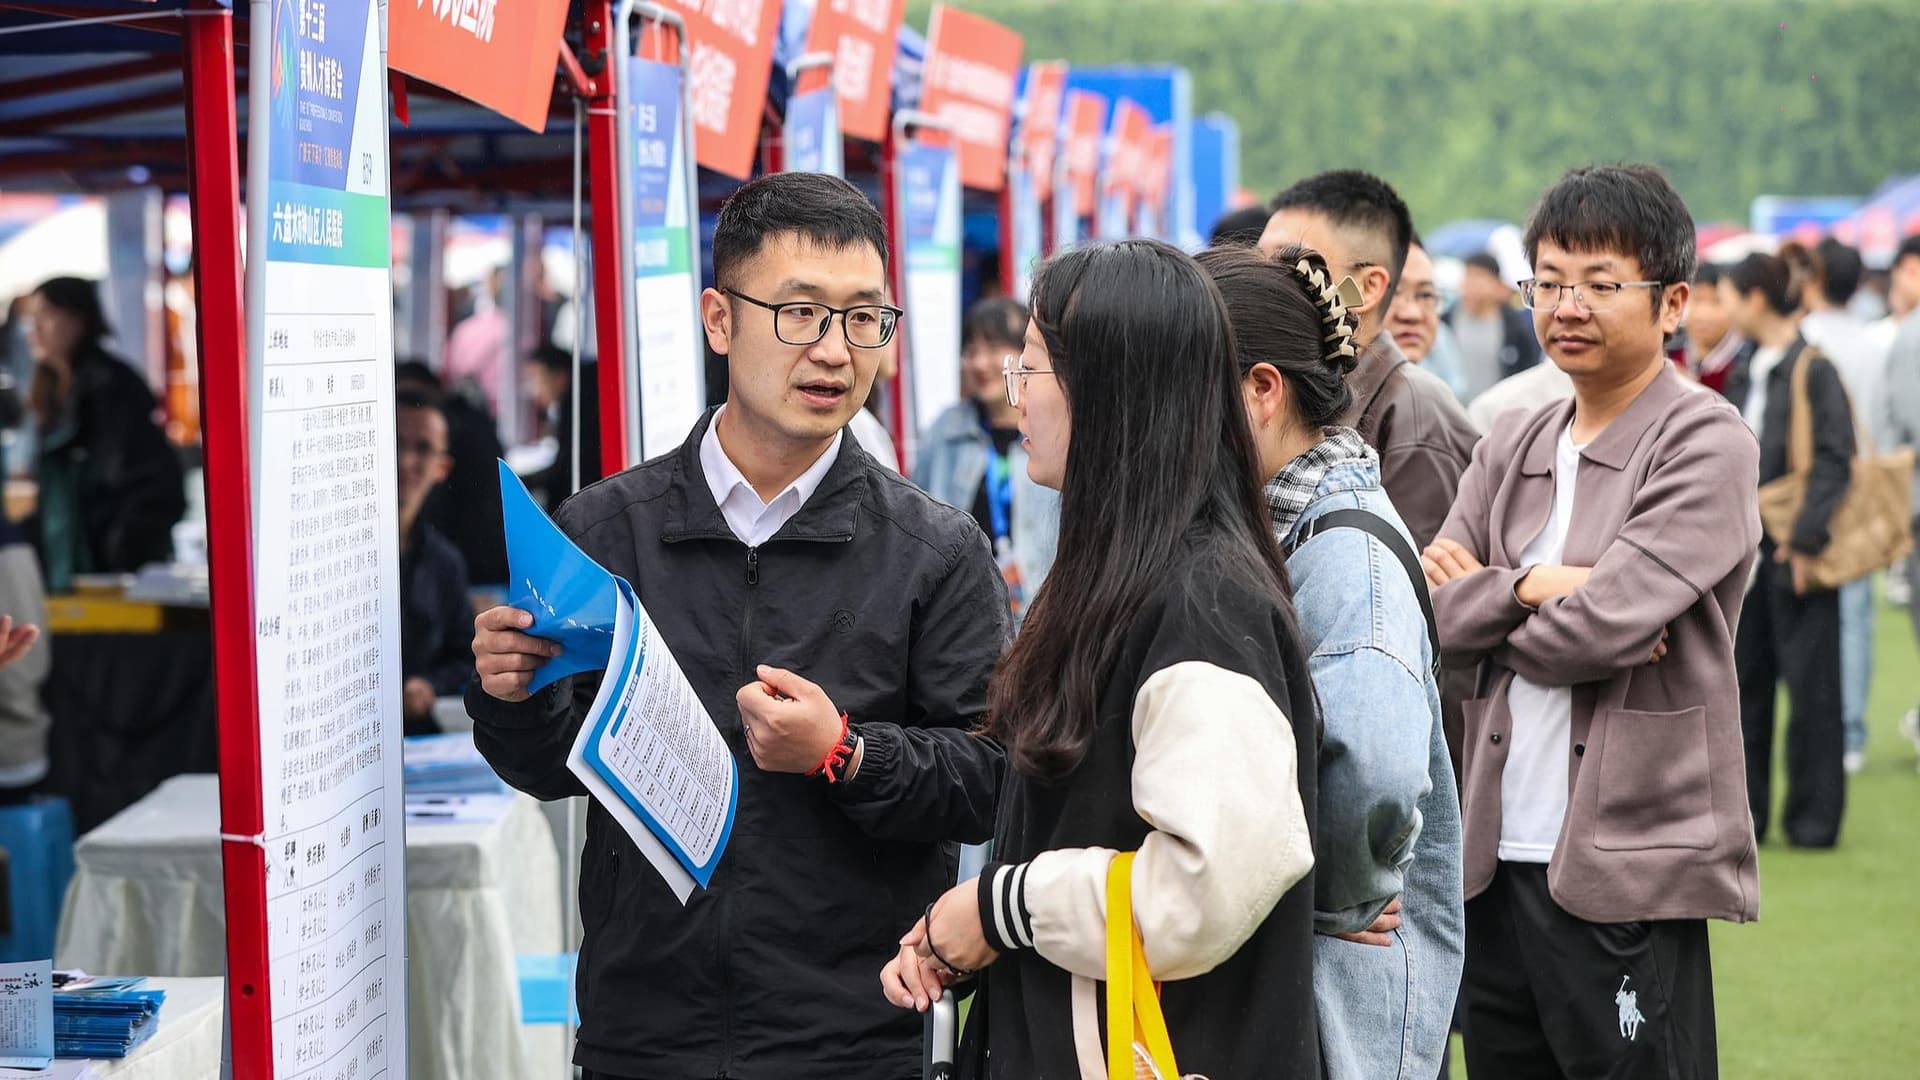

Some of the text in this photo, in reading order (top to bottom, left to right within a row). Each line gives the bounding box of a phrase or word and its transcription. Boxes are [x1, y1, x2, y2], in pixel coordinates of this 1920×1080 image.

[300, 49, 343, 100] 贵州人才博览会
